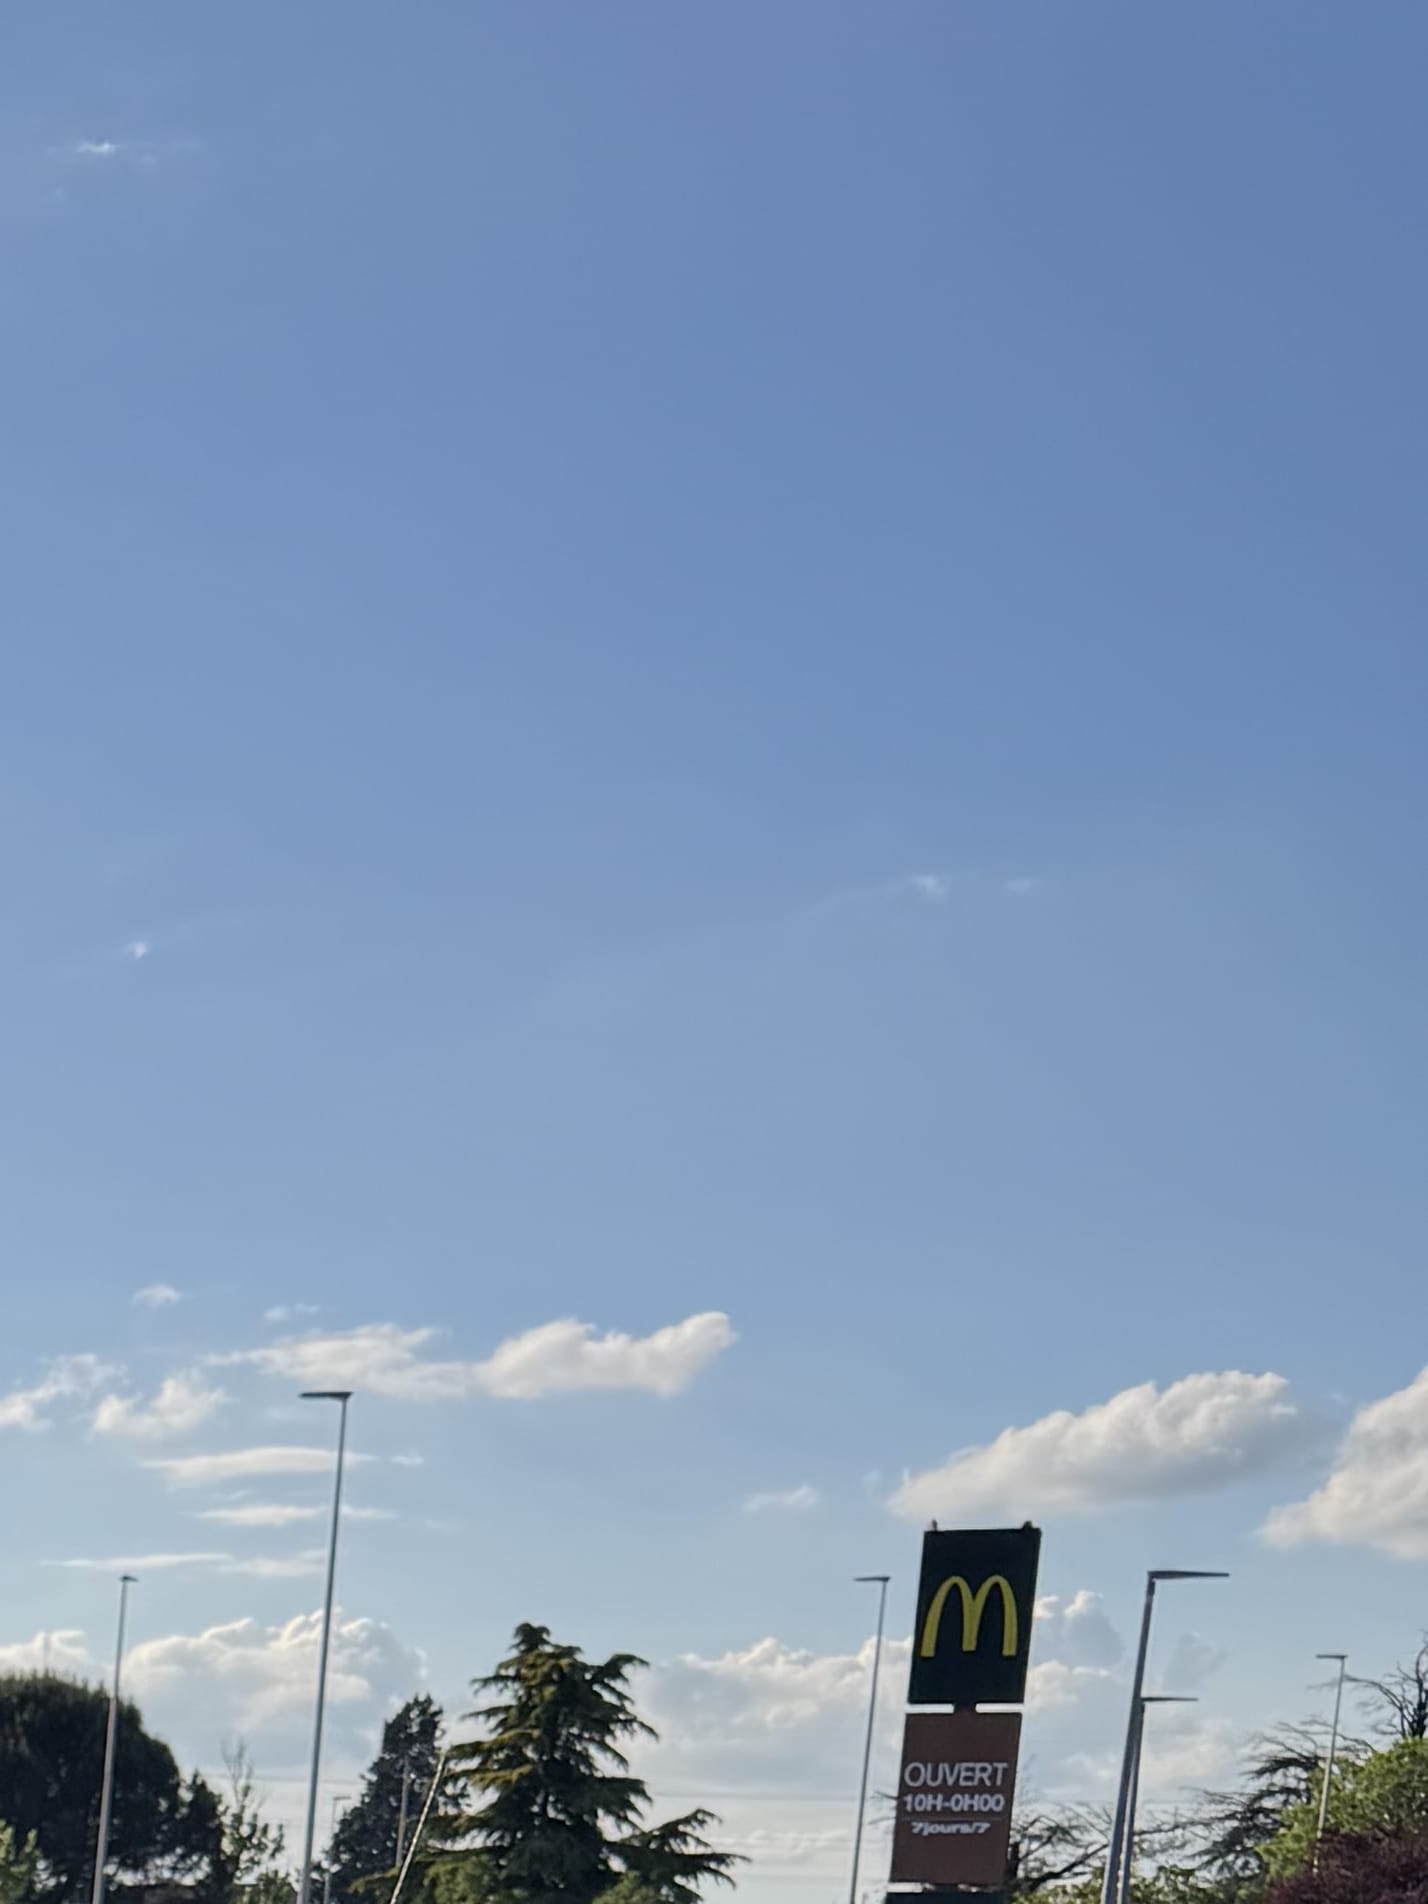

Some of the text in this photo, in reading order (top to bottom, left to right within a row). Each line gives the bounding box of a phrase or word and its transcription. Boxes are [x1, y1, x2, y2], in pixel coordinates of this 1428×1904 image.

[903, 1761, 1008, 1788] OUVERT
[904, 1793, 1005, 1813] 10H-0H00
[911, 1821, 991, 1837] 7jours/7
